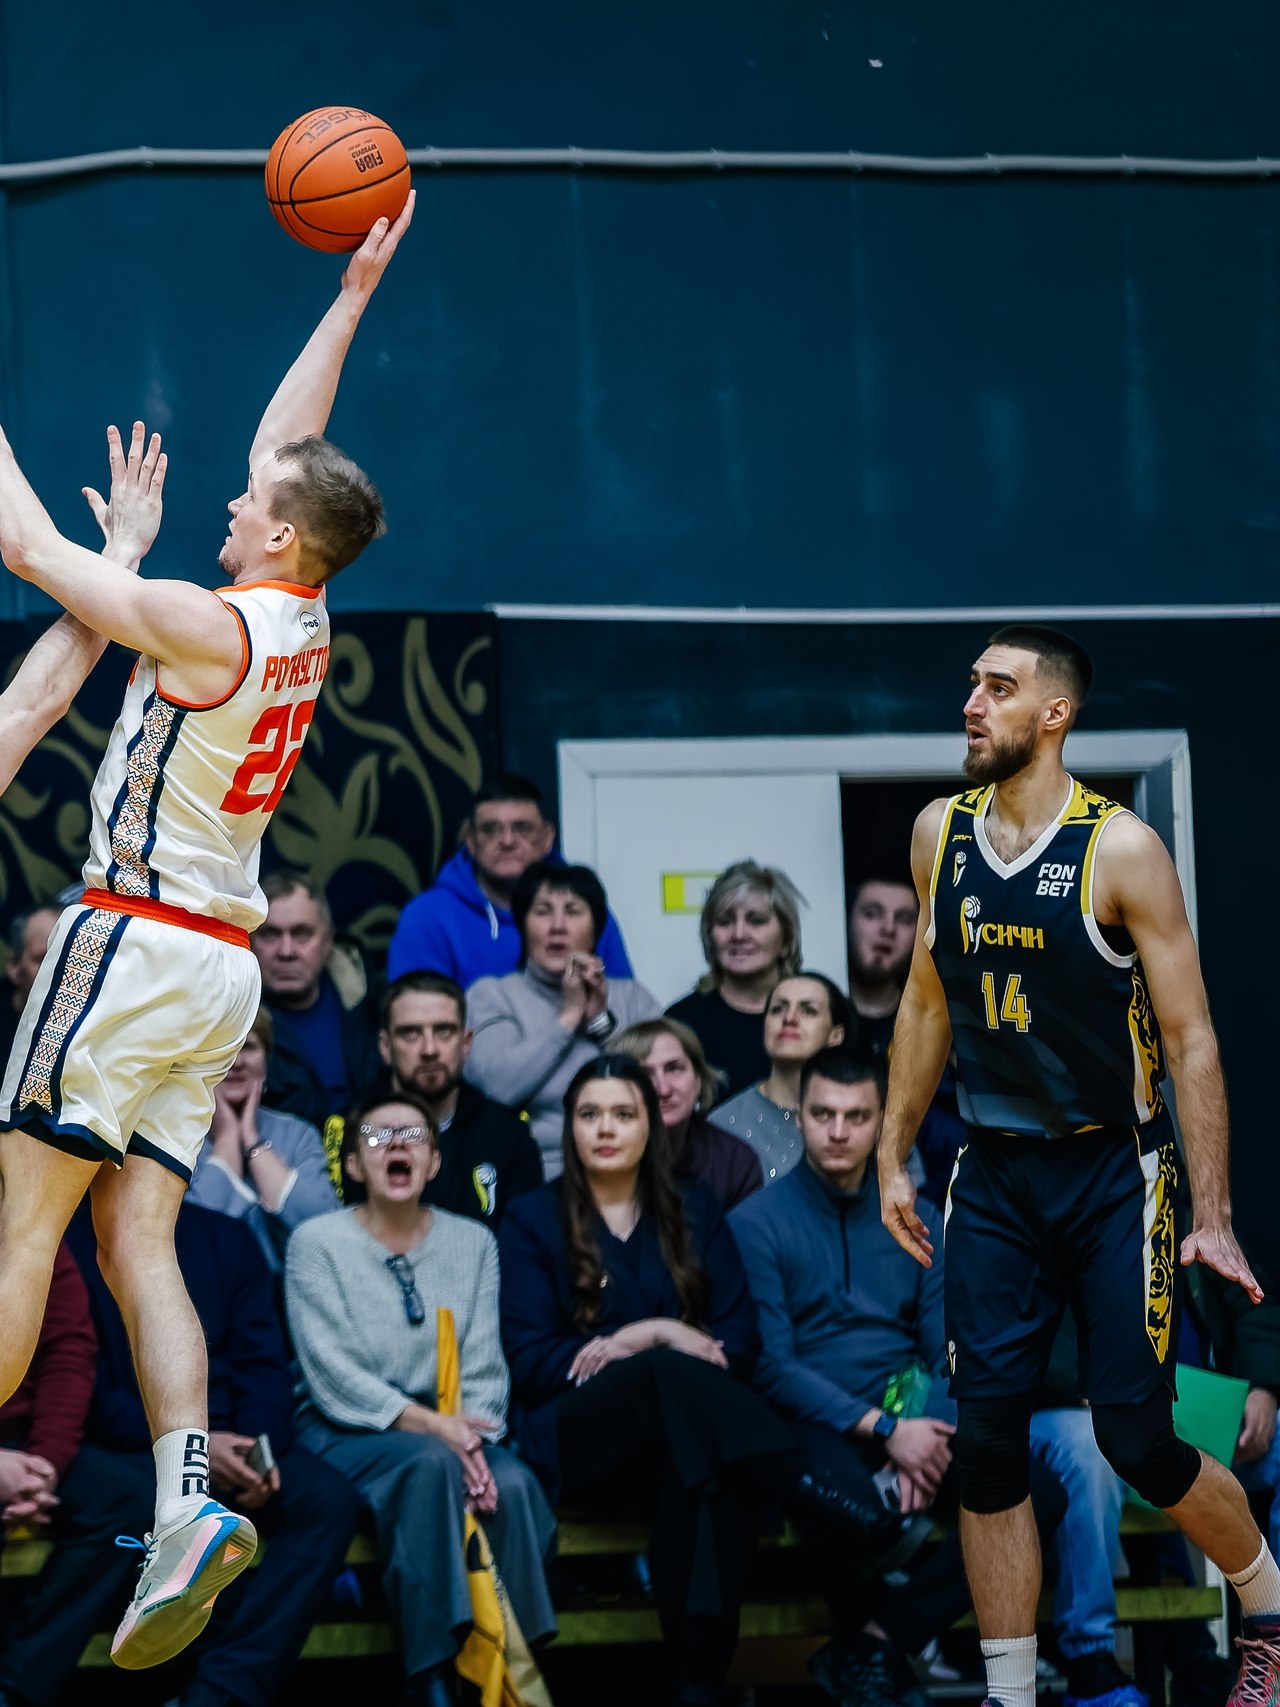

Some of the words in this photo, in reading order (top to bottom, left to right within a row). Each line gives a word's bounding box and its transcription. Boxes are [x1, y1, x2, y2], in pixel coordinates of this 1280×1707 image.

[354, 150, 384, 173] FIBA
[219, 699, 318, 815] 22
[1037, 863, 1076, 880] FON
[1035, 880, 1074, 897] BET
[982, 972, 1031, 1032] 14
